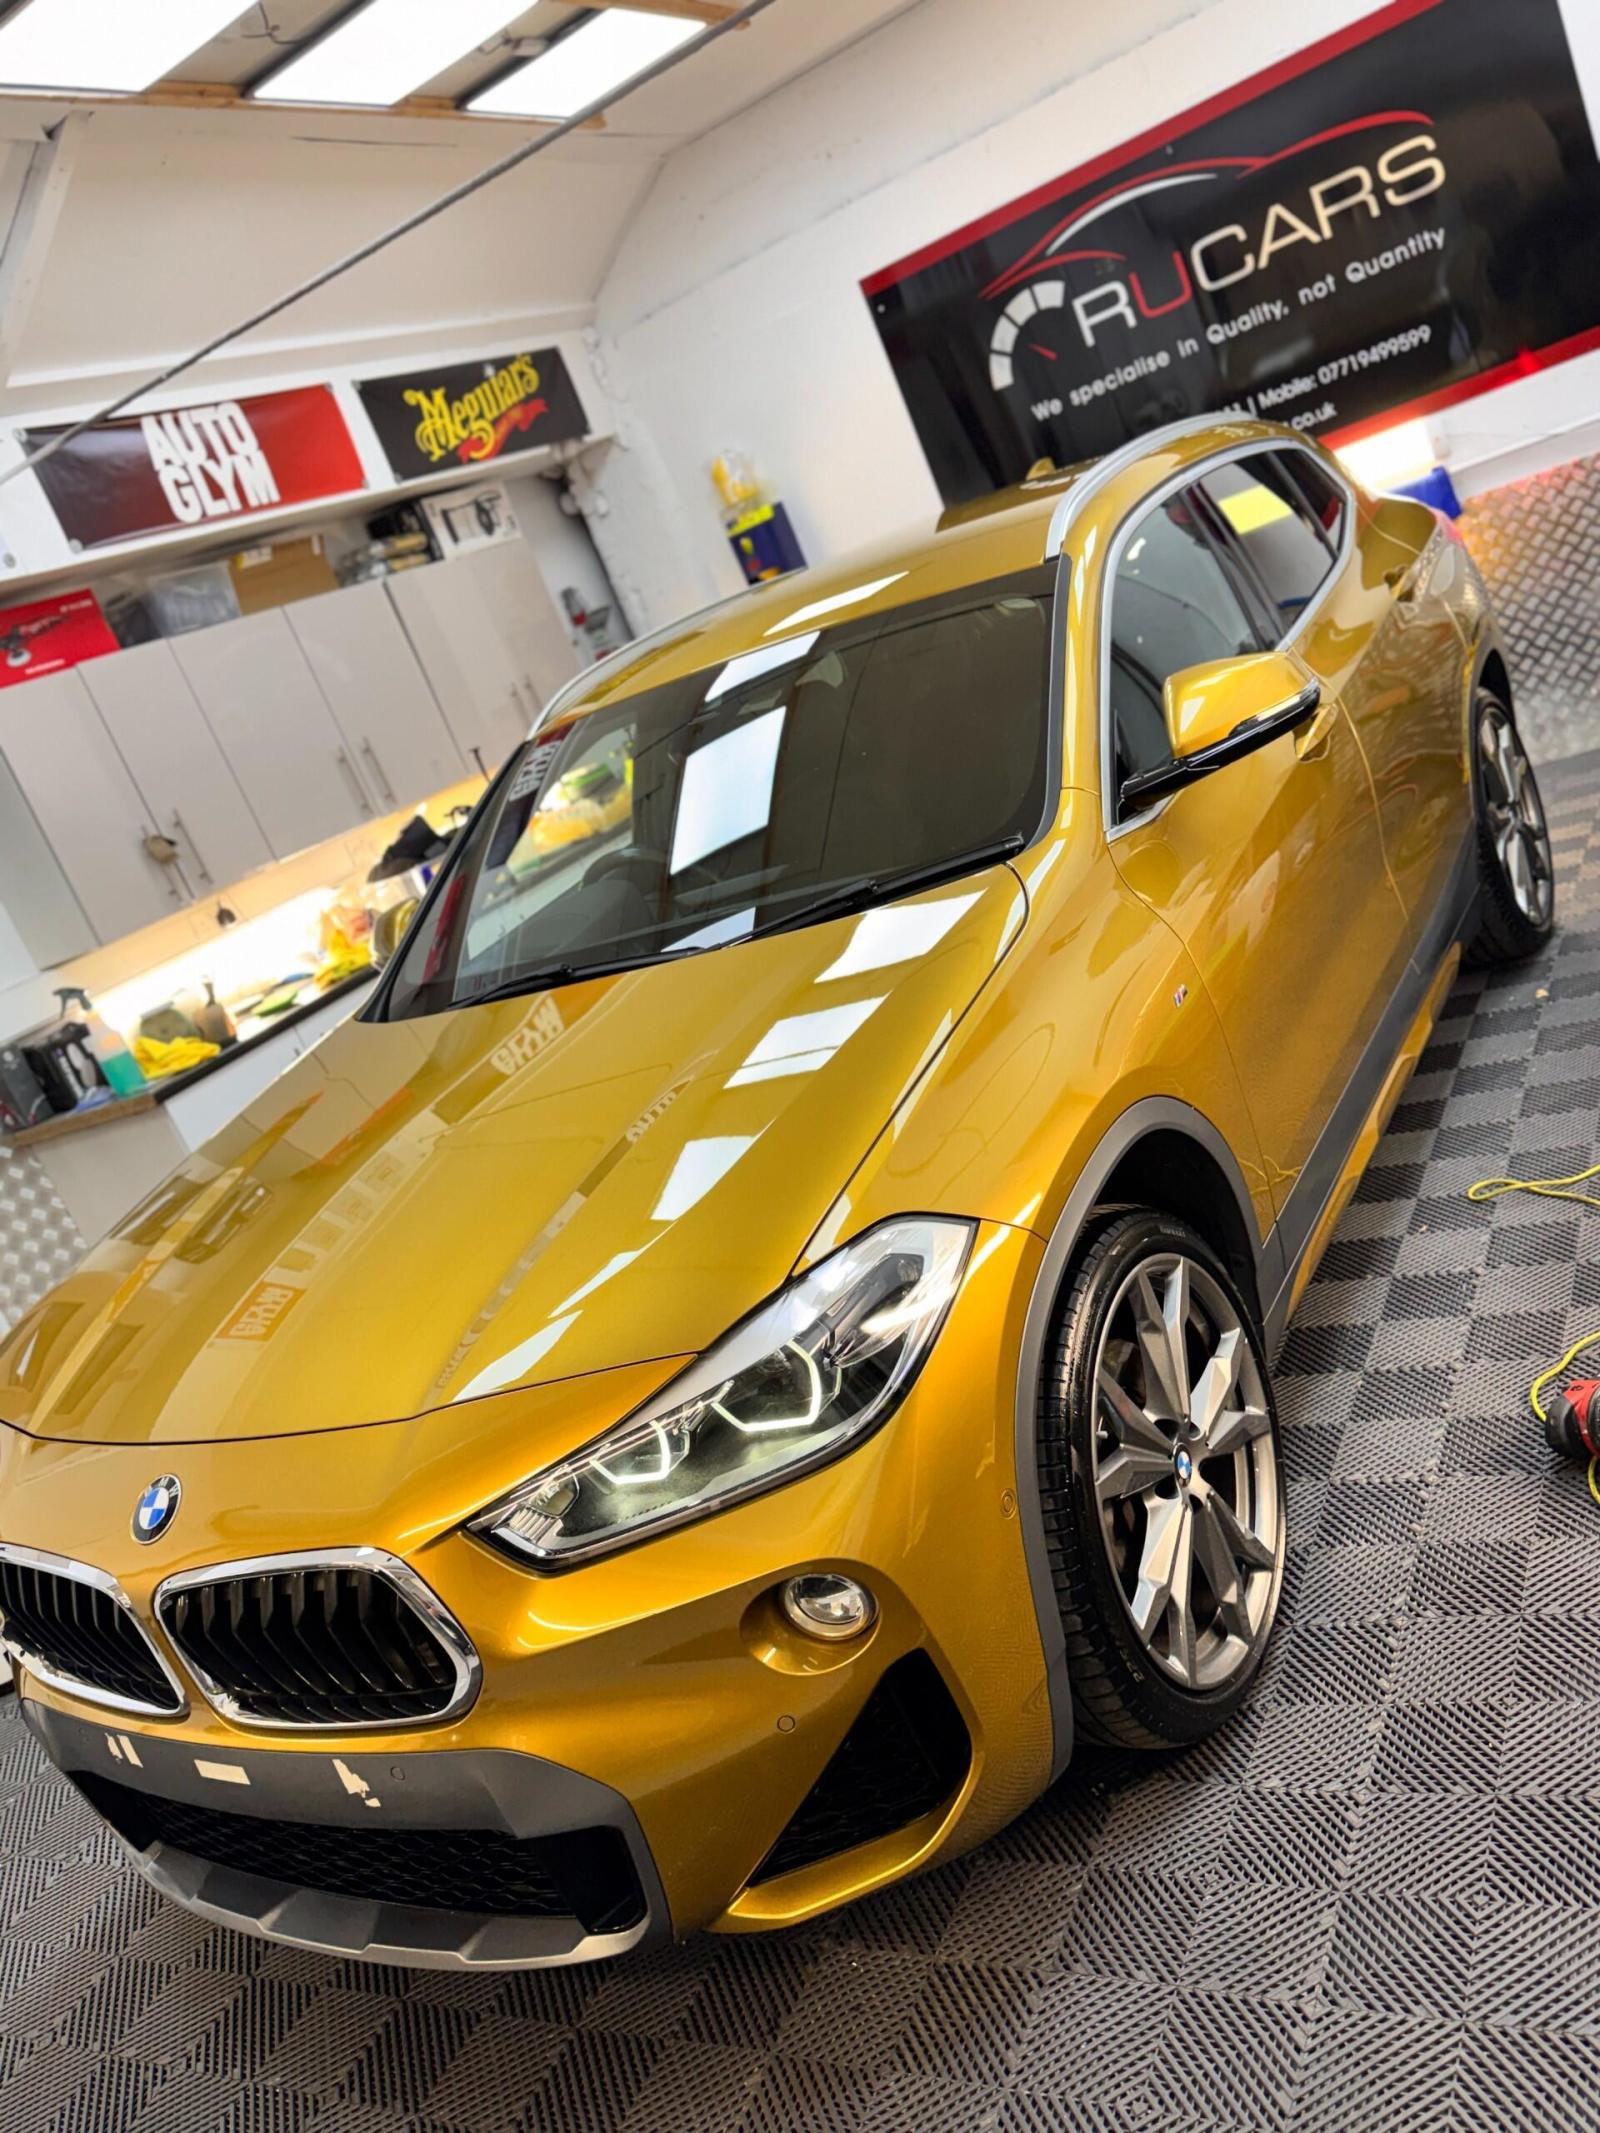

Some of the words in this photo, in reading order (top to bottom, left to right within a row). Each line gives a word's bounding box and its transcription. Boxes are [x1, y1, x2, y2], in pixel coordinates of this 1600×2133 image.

[1030, 401, 1063, 423] We
[1069, 350, 1170, 405] specialise
[1177, 338, 1199, 358] in
[1206, 299, 1289, 344] Quality,
[1298, 273, 1336, 305] not
[1345, 228, 1446, 283] Quantity
[1257, 375, 1318, 410] Mobile:
[1317, 324, 1431, 384] 07719499599
[141, 400, 259, 472] AUTO
[158, 448, 281, 524] GLYM
